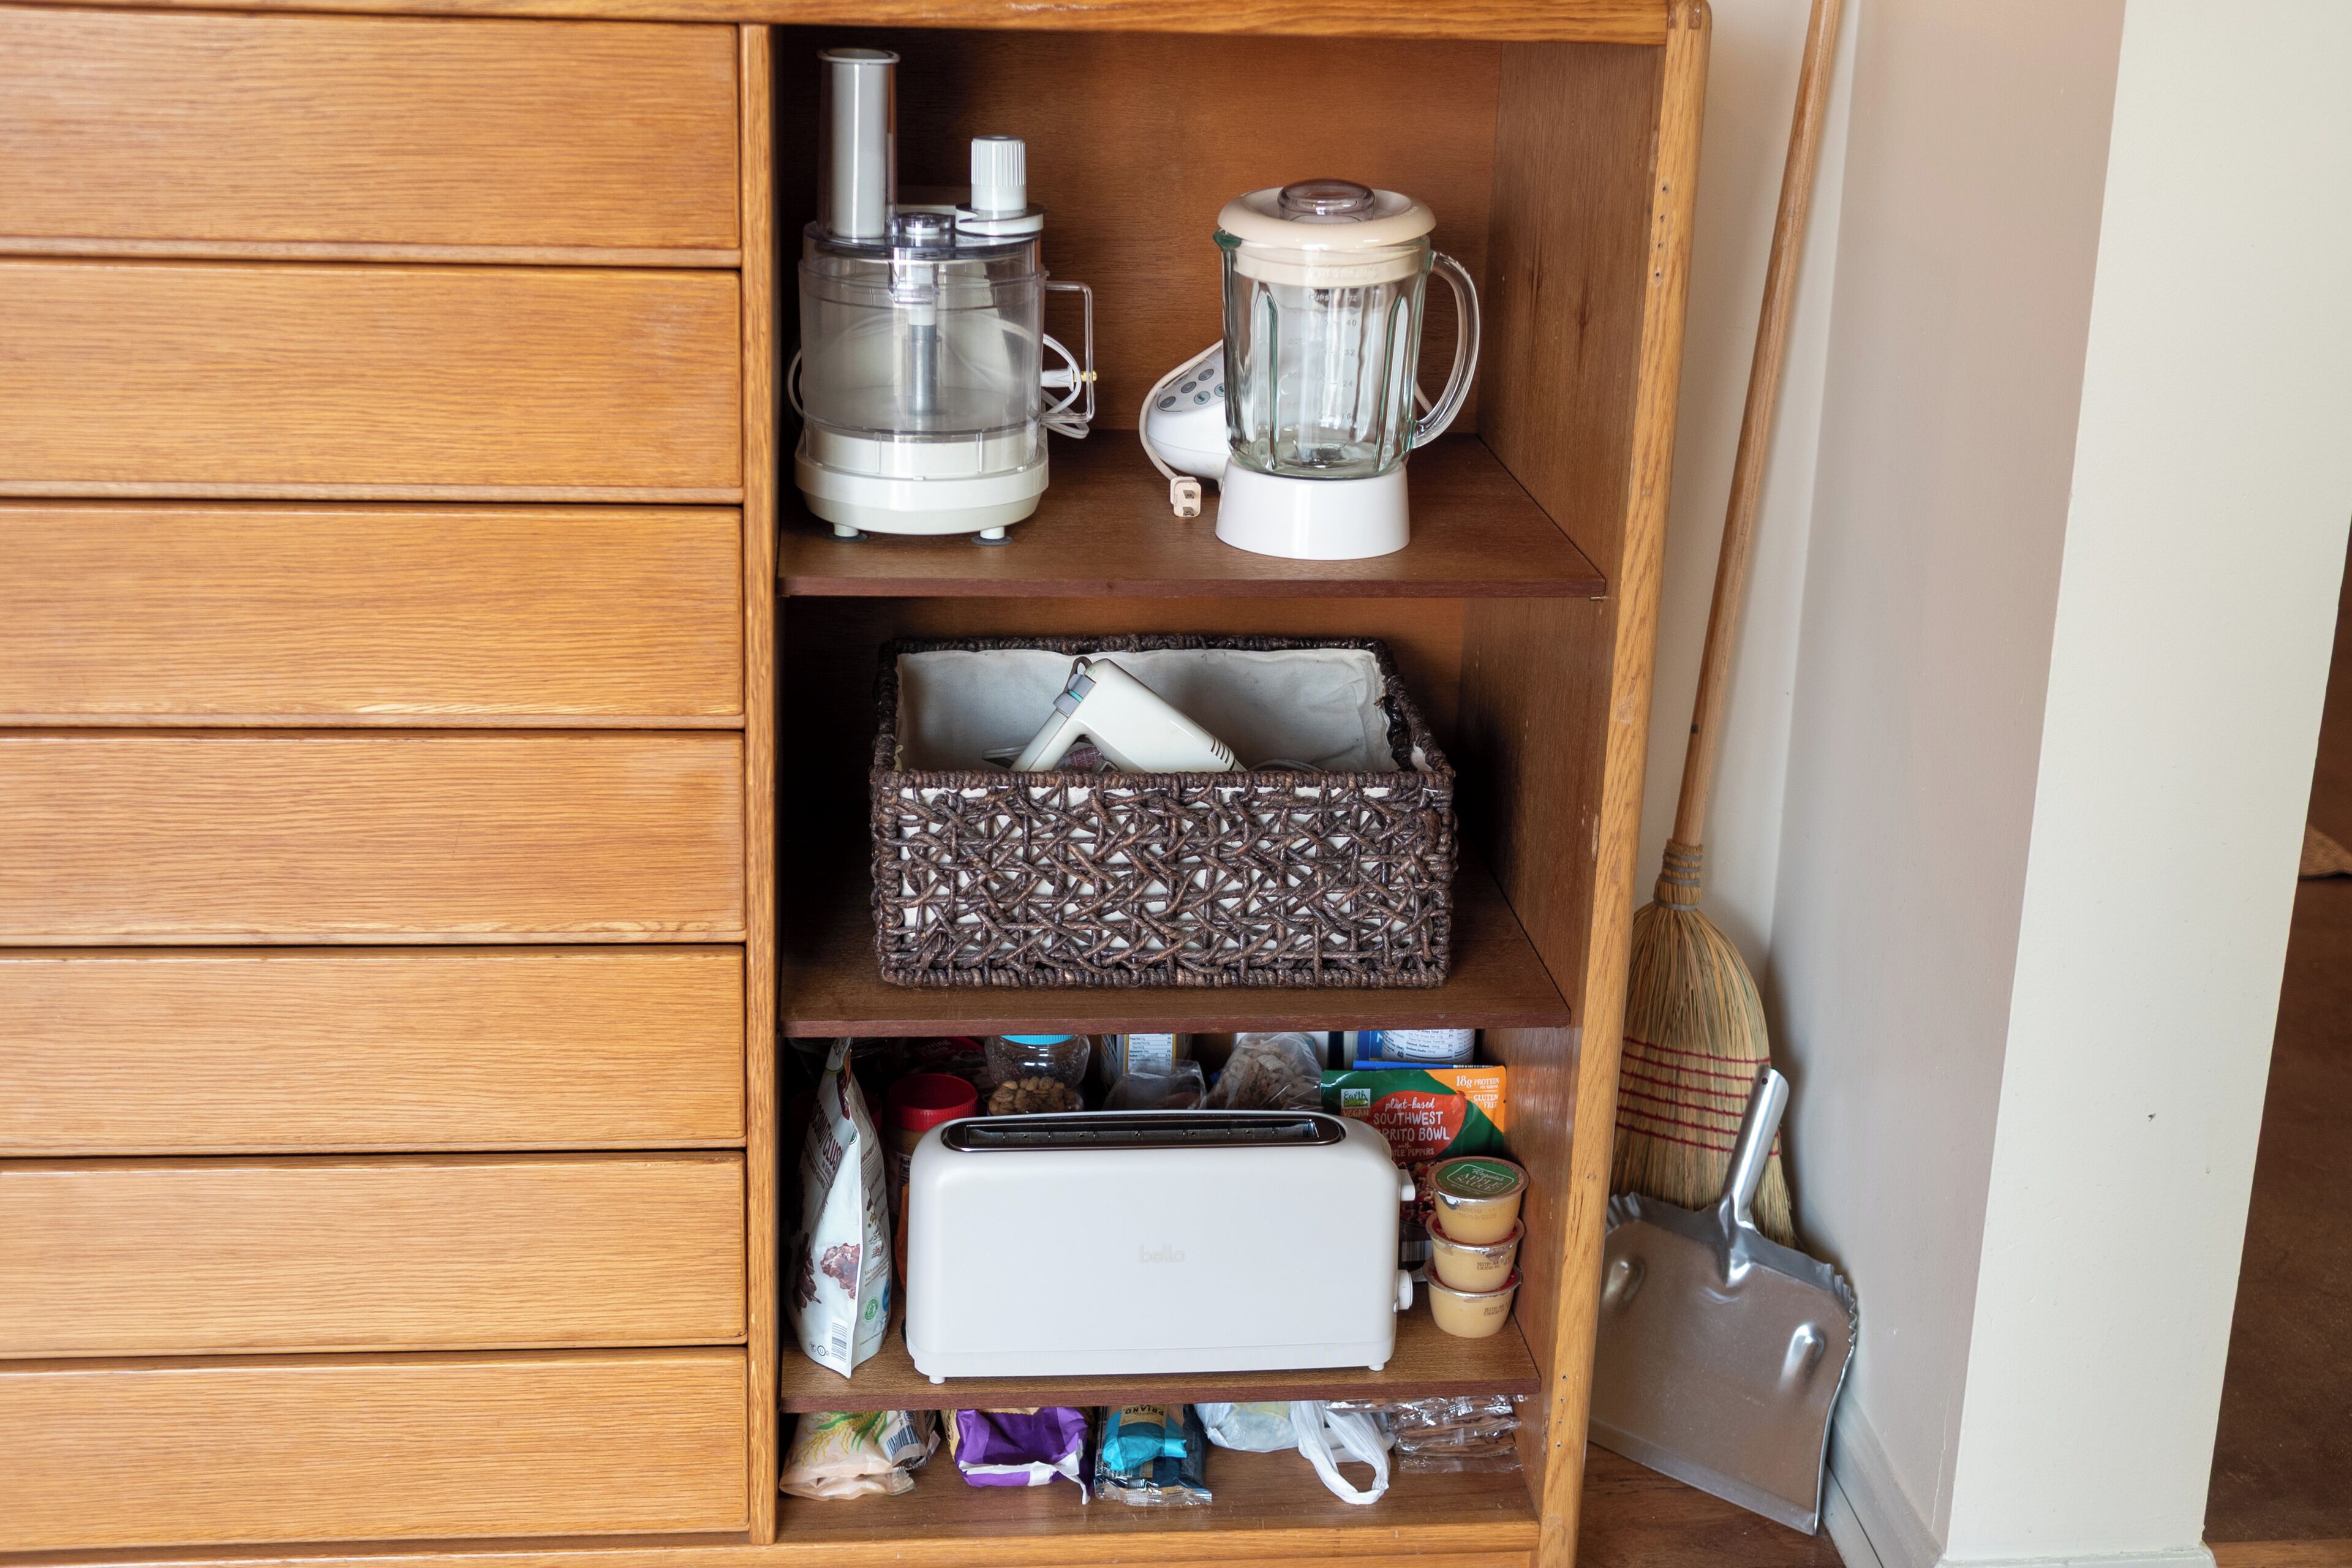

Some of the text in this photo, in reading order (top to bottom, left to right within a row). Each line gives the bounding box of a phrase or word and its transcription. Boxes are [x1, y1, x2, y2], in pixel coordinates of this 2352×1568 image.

[1456, 1076, 1472, 1088] 18g
[1343, 1090, 1368, 1100] Earth
[1385, 1097, 1435, 1112] plant-based
[1373, 1111, 1444, 1126] SOUTHWEST
[1379, 1126, 1450, 1142] RRITO BOWL
[1408, 1148, 1434, 1156] PEPPERS
[900, 1156, 911, 1165] Nut
[1460, 1173, 1503, 1189] APPLE
[1472, 1168, 1504, 1181] Regular
[1455, 1175, 1496, 1193] SAUCE
[1139, 1243, 1185, 1264] bella
[1125, 1404, 1164, 1416] PRIANO
